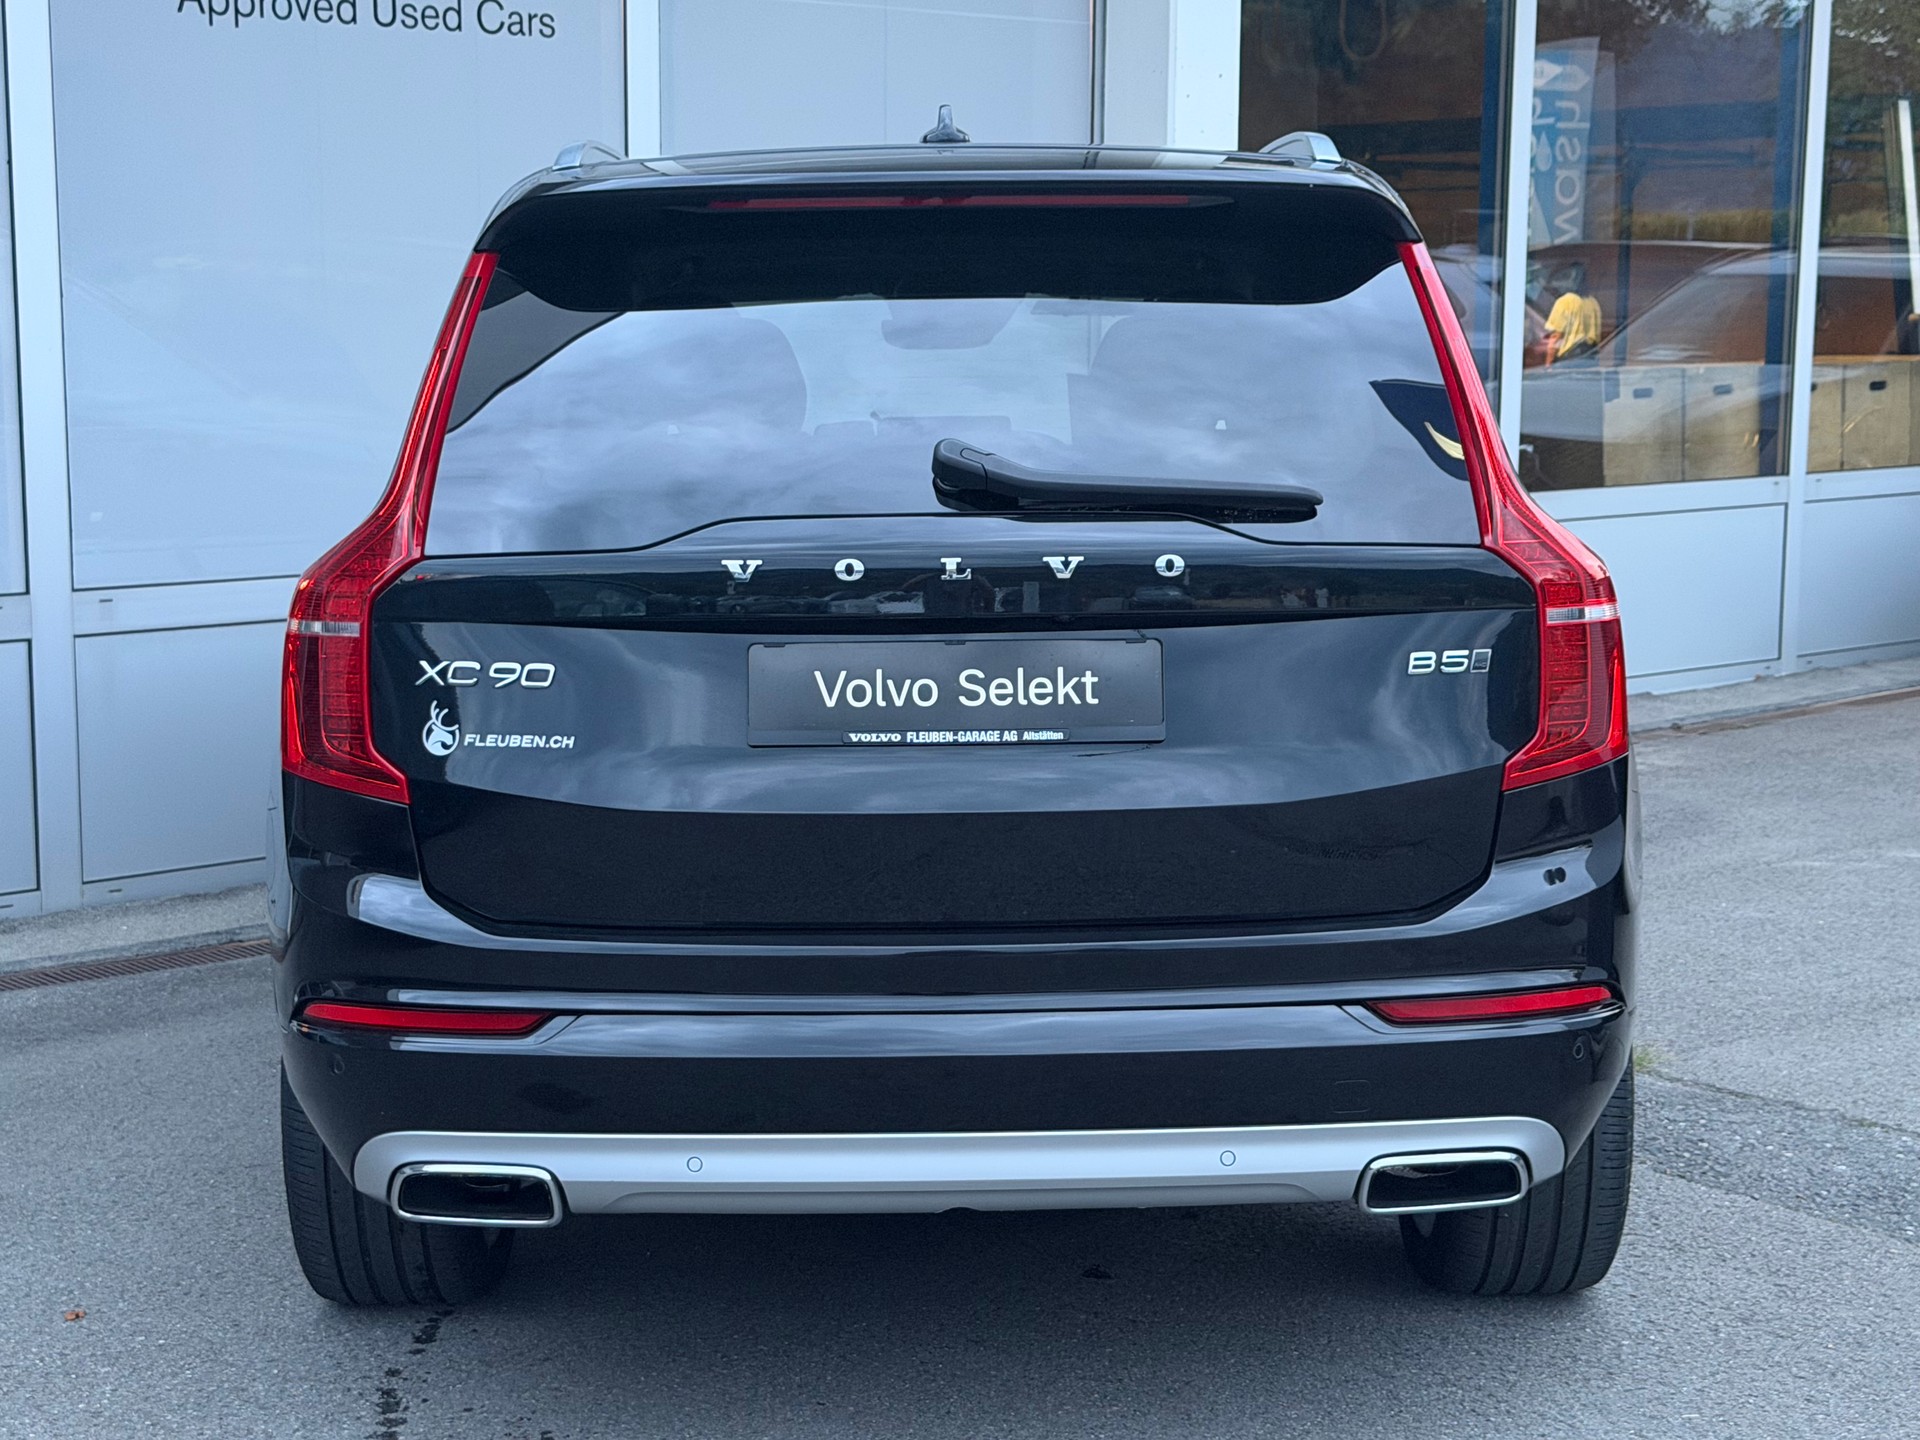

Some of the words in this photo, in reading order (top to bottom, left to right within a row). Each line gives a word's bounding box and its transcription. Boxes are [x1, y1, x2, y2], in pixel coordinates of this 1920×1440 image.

[373, 0, 462, 32] Used
[477, 0, 556, 38] Cars
[721, 553, 1186, 583] VOLVO
[813, 668, 939, 708] Volvo
[957, 666, 1099, 707] Selekt
[463, 733, 576, 749] FLEUBEN.CH
[848, 732, 902, 743] VOLVO
[906, 730, 1000, 743] FLEUBEN-GARAGE
[1002, 730, 1018, 742] AG
[1022, 730, 1064, 741] Altstätten
